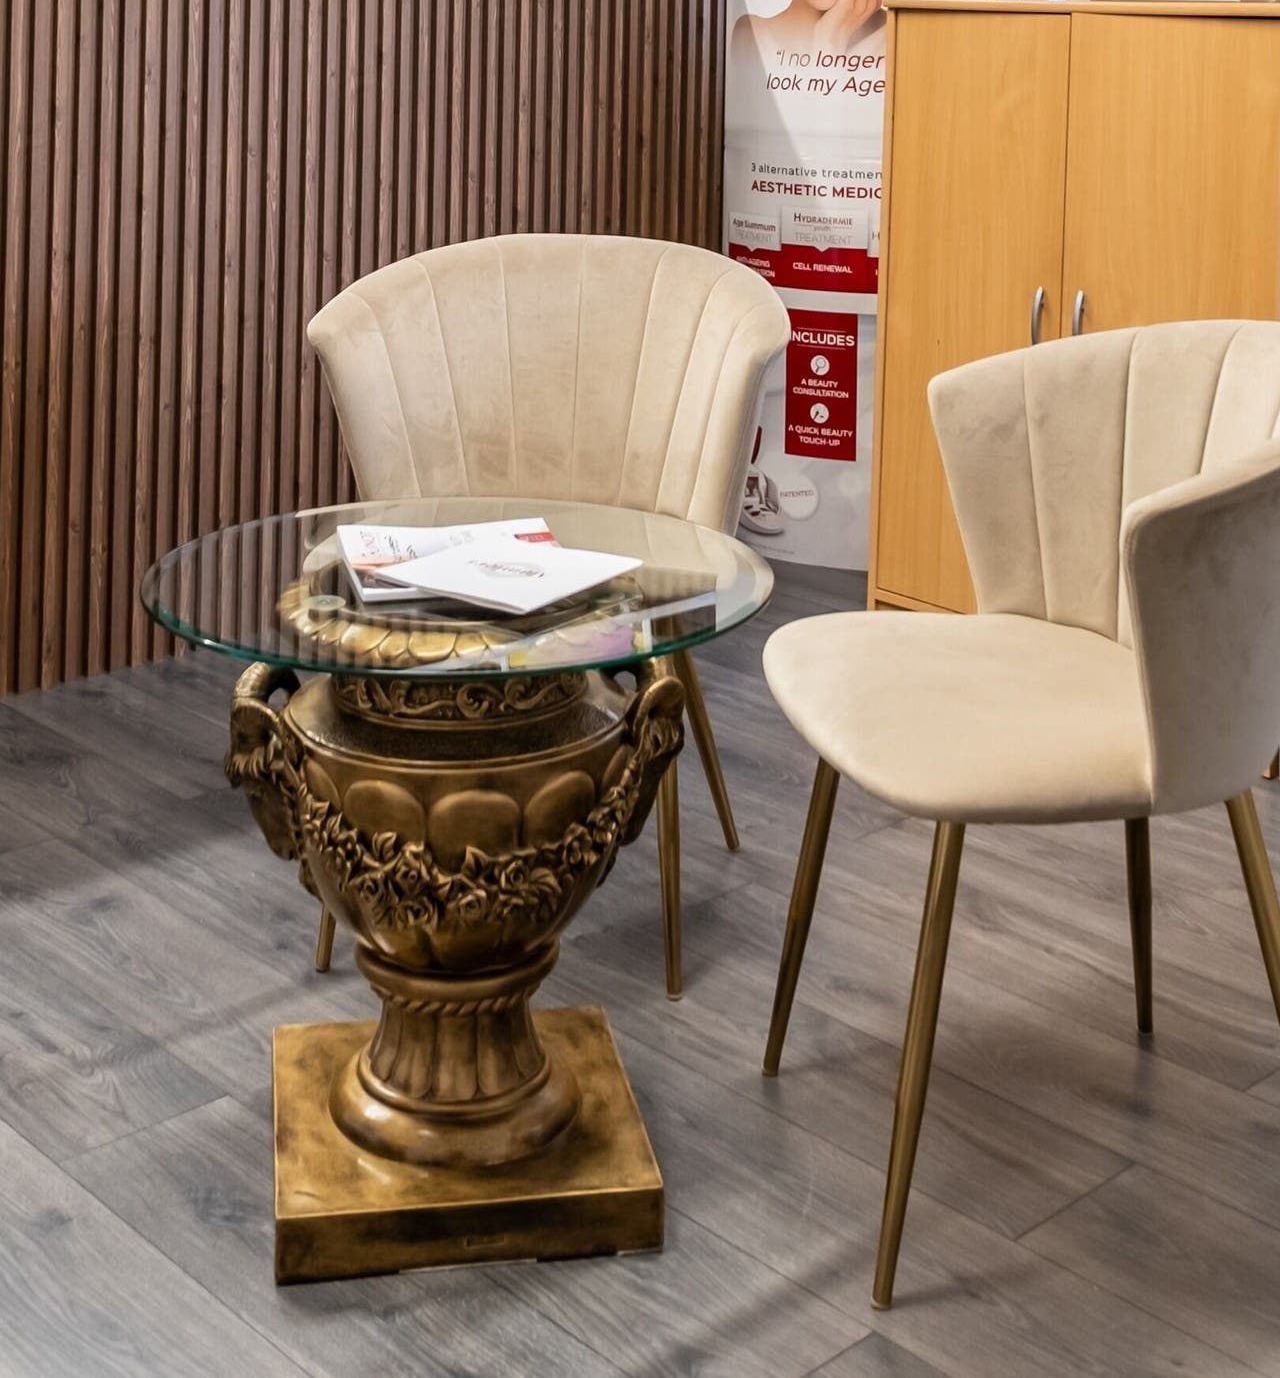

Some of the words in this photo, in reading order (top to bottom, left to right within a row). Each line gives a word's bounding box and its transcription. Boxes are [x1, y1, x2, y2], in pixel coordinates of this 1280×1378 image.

[788, 53, 811, 67] no
[815, 51, 885, 72] longer
[766, 73, 803, 91] look
[807, 78, 838, 96] my
[842, 76, 886, 97] Age
[758, 164, 818, 178] alternative
[751, 179, 827, 197] AESTHETIC
[733, 218, 744, 228] Age
[744, 219, 776, 232] Summum
[795, 231, 853, 245] TREATMENT
[792, 262, 812, 271] CELL
[813, 263, 853, 274] RENEWAL
[808, 378, 839, 389] BEAUTY
[793, 387, 849, 399] CONSULTATION
[795, 426, 820, 435] QUICK
[821, 429, 853, 437] BEAUTY
[799, 436, 841, 447] TOUCH-UP
[779, 489, 815, 499] PATENTED
